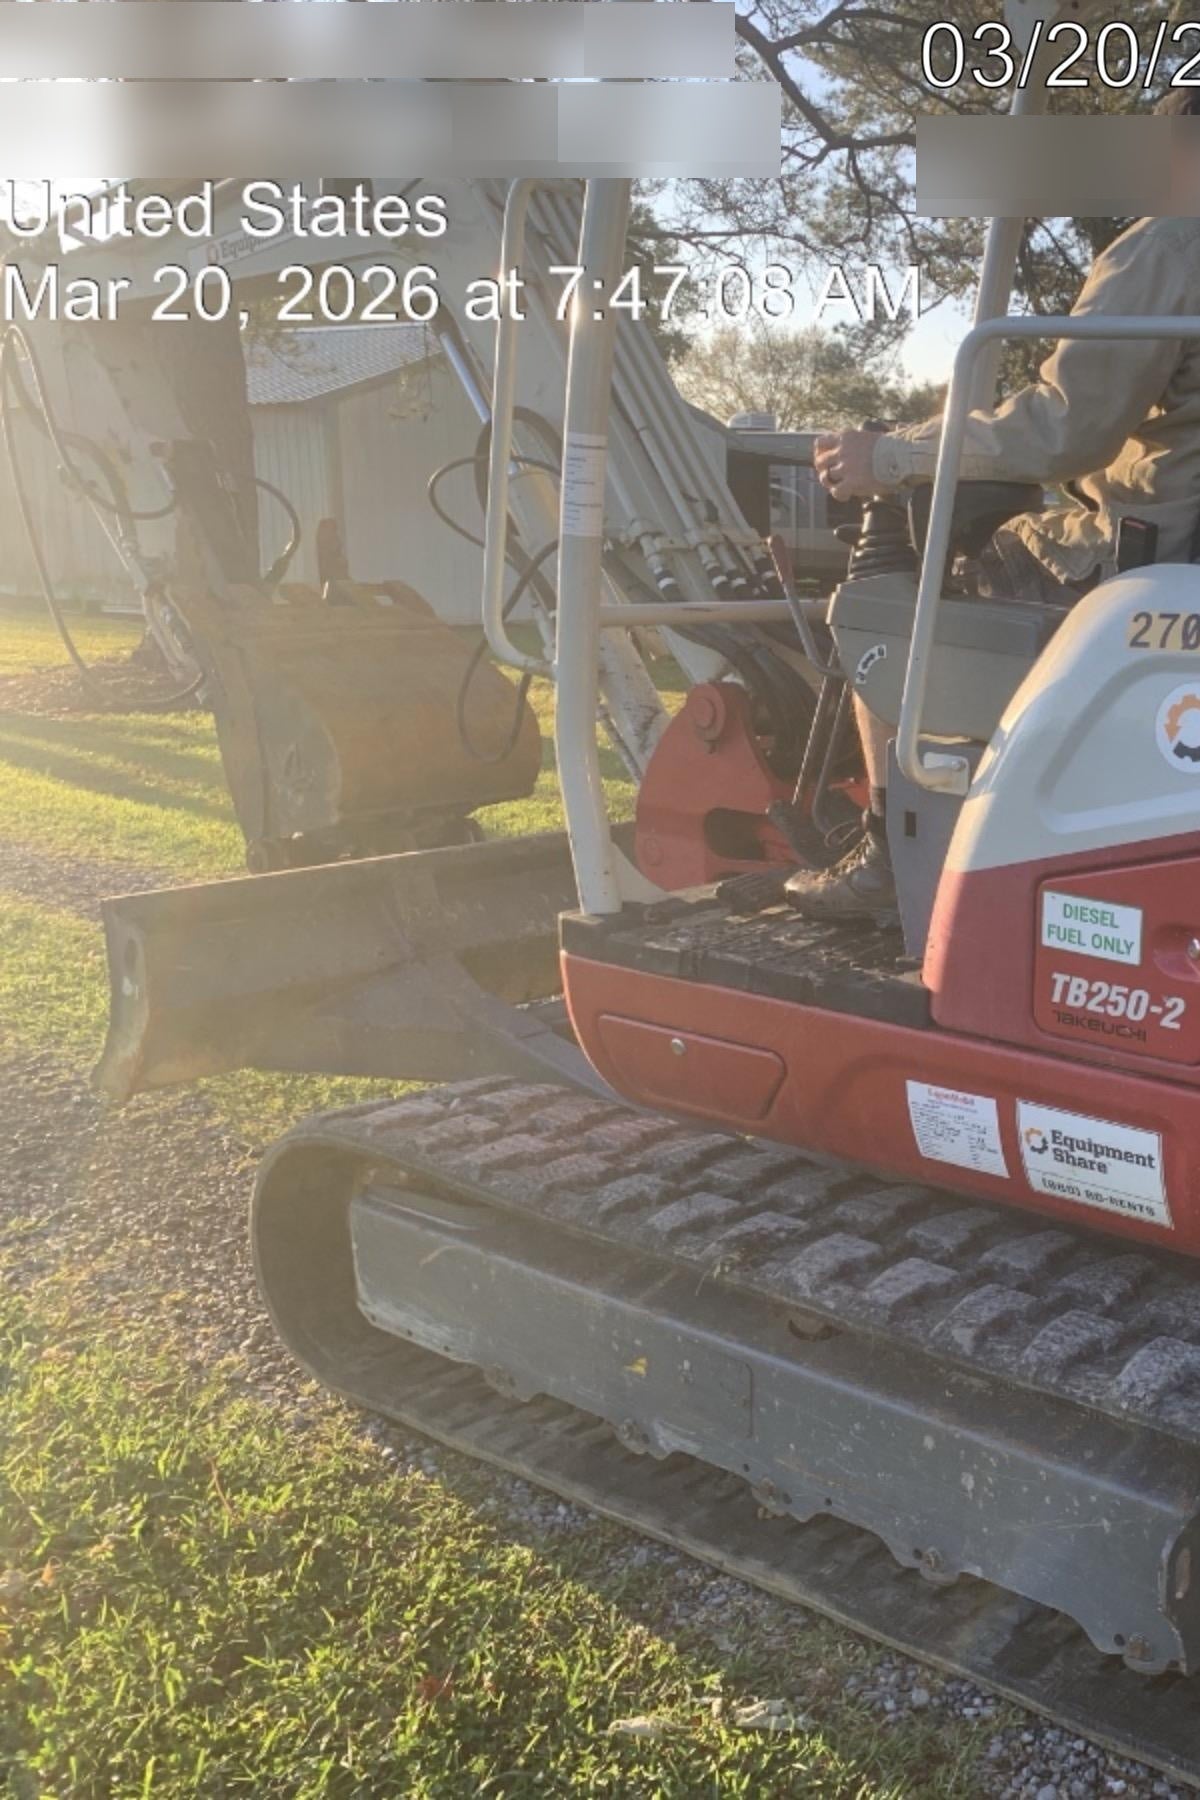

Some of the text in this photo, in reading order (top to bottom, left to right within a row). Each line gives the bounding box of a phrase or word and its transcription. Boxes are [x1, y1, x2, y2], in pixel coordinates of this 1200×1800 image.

[1063, 903, 1119, 928] DIESEL
[1047, 924, 1134, 955] FUEL ONLY
[1051, 972, 1185, 1030] TB250-2
[1053, 1010, 1147, 1042] TAKEUCHI
[1051, 1129, 1155, 1169] Equipment
[1052, 1148, 1108, 1174] Share
